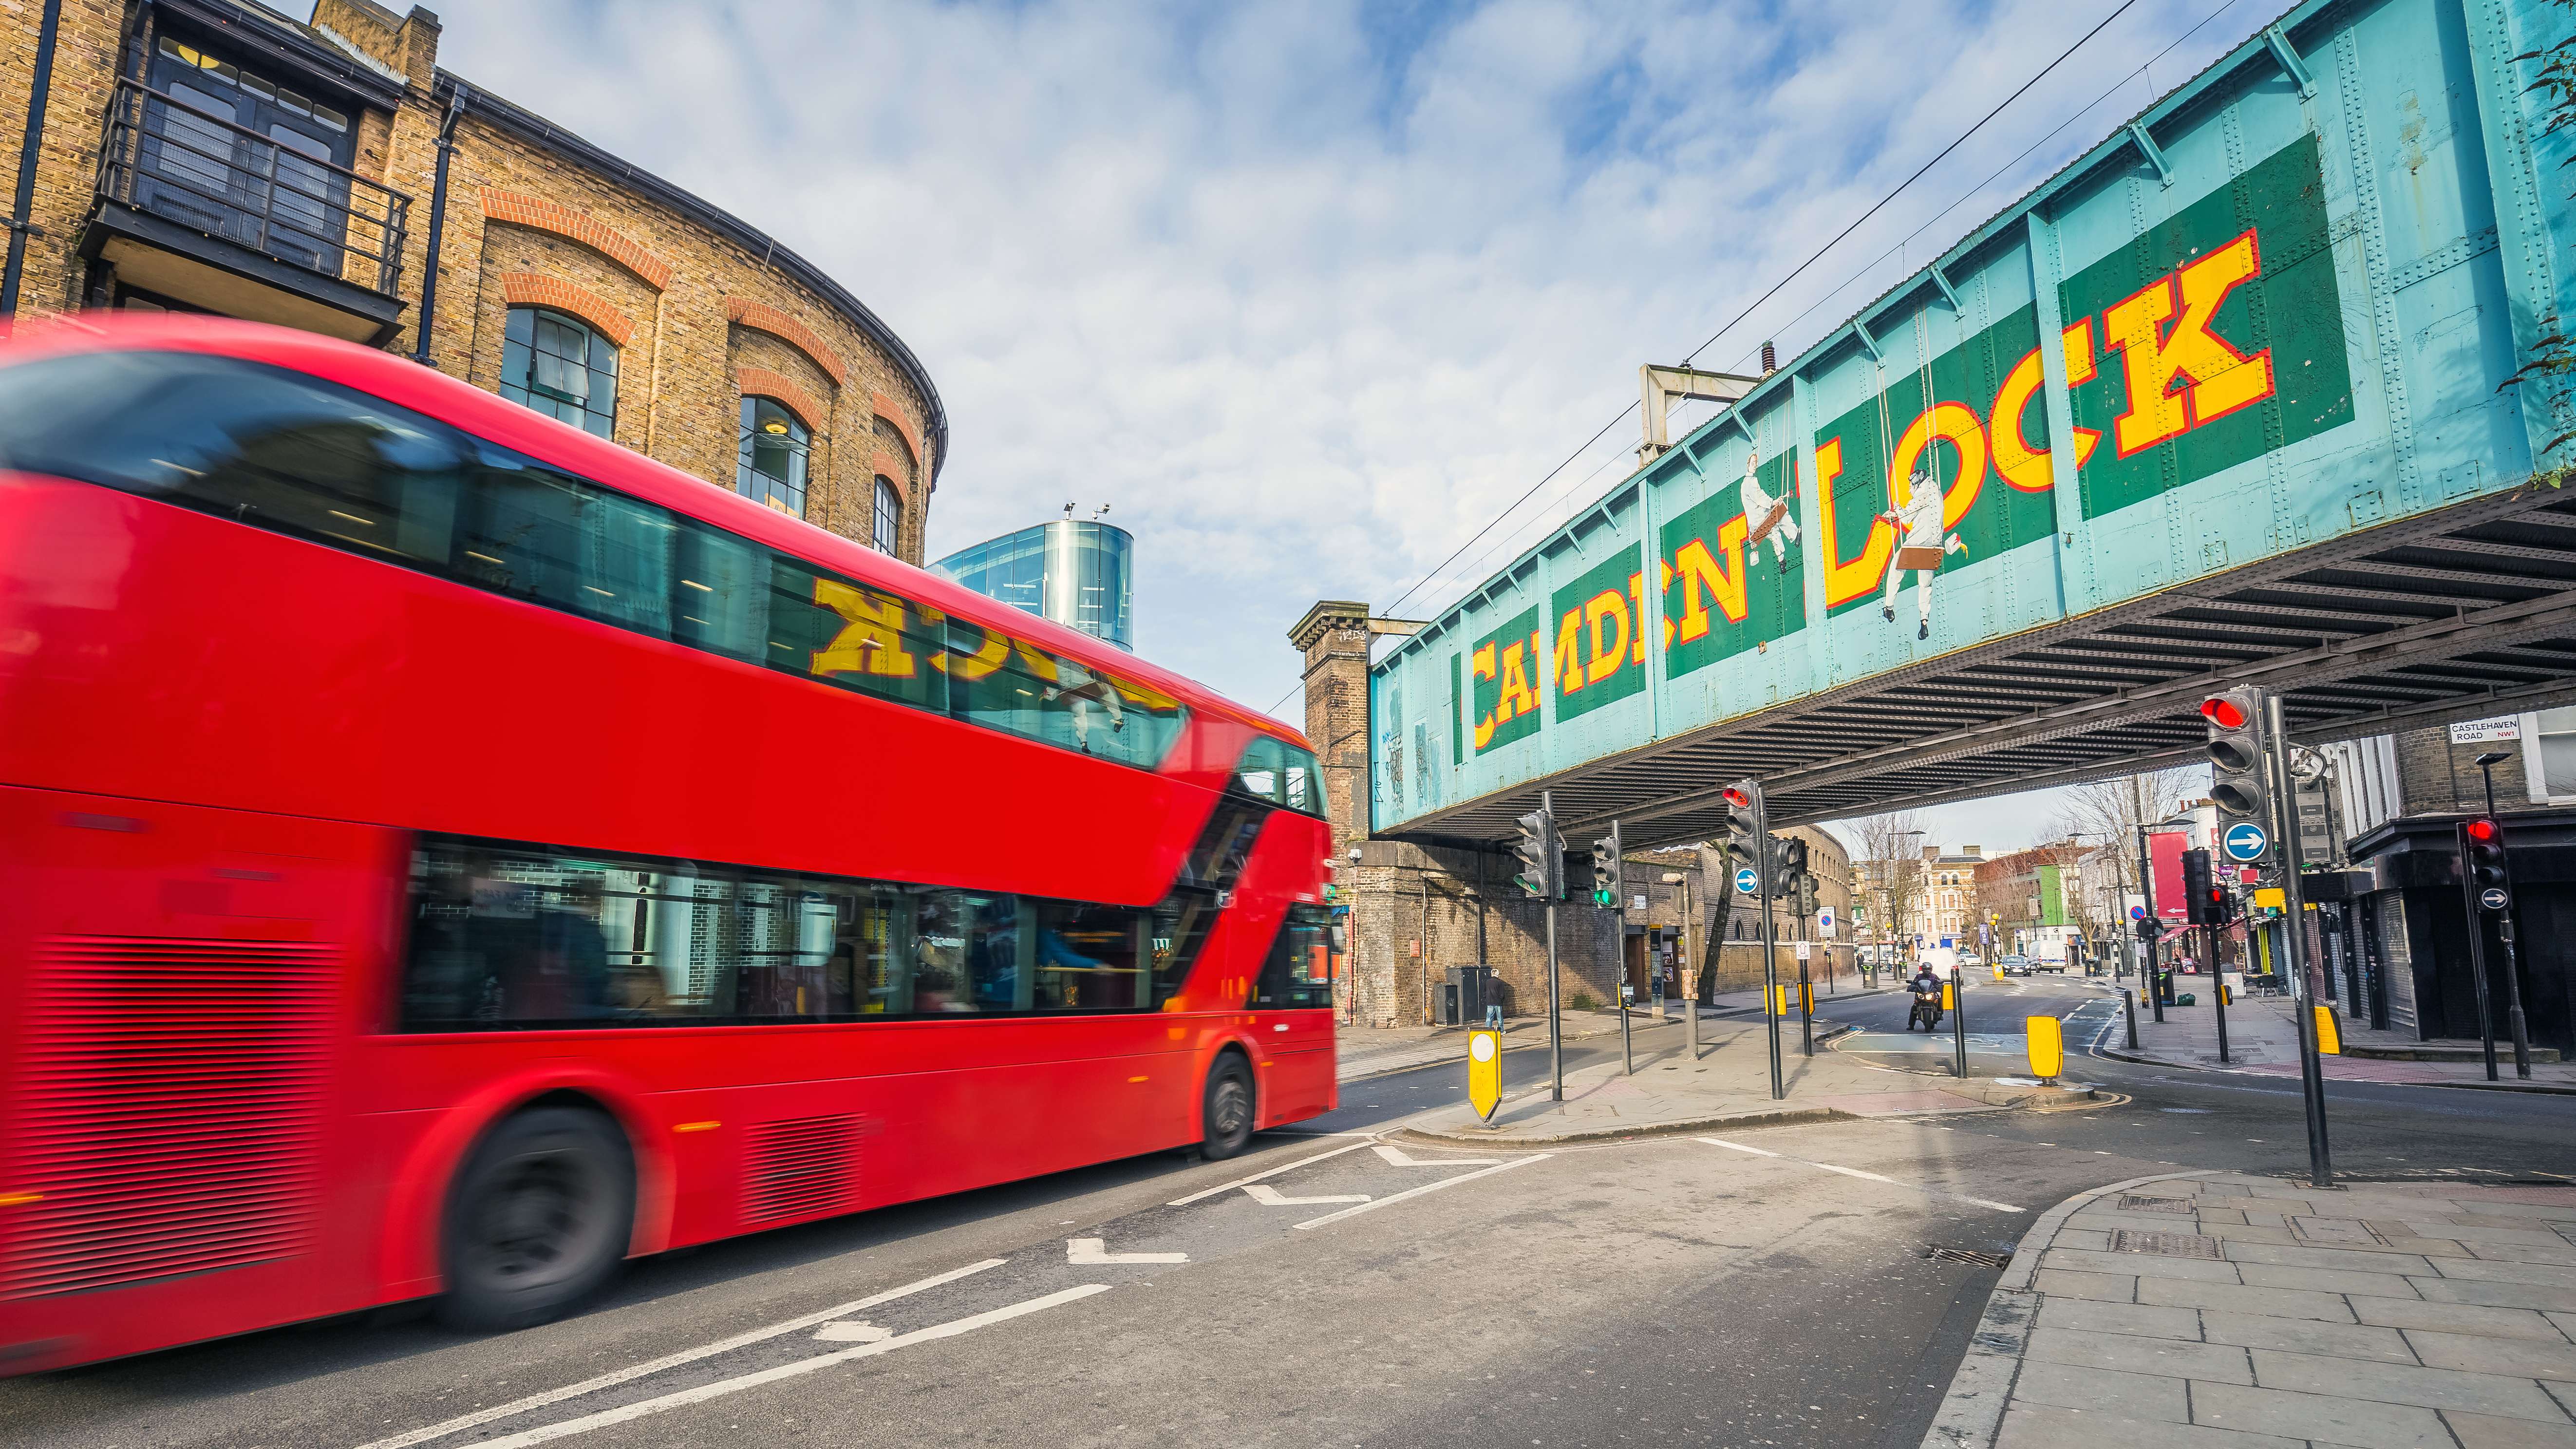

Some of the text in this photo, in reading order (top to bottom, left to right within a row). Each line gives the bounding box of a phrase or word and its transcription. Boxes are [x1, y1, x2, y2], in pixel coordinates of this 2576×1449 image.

[1461, 227, 2275, 750] CAMDEN LOCK
[2452, 721, 2517, 732] CASTLEHAVEN
[2457, 732, 2483, 740] ROAD
